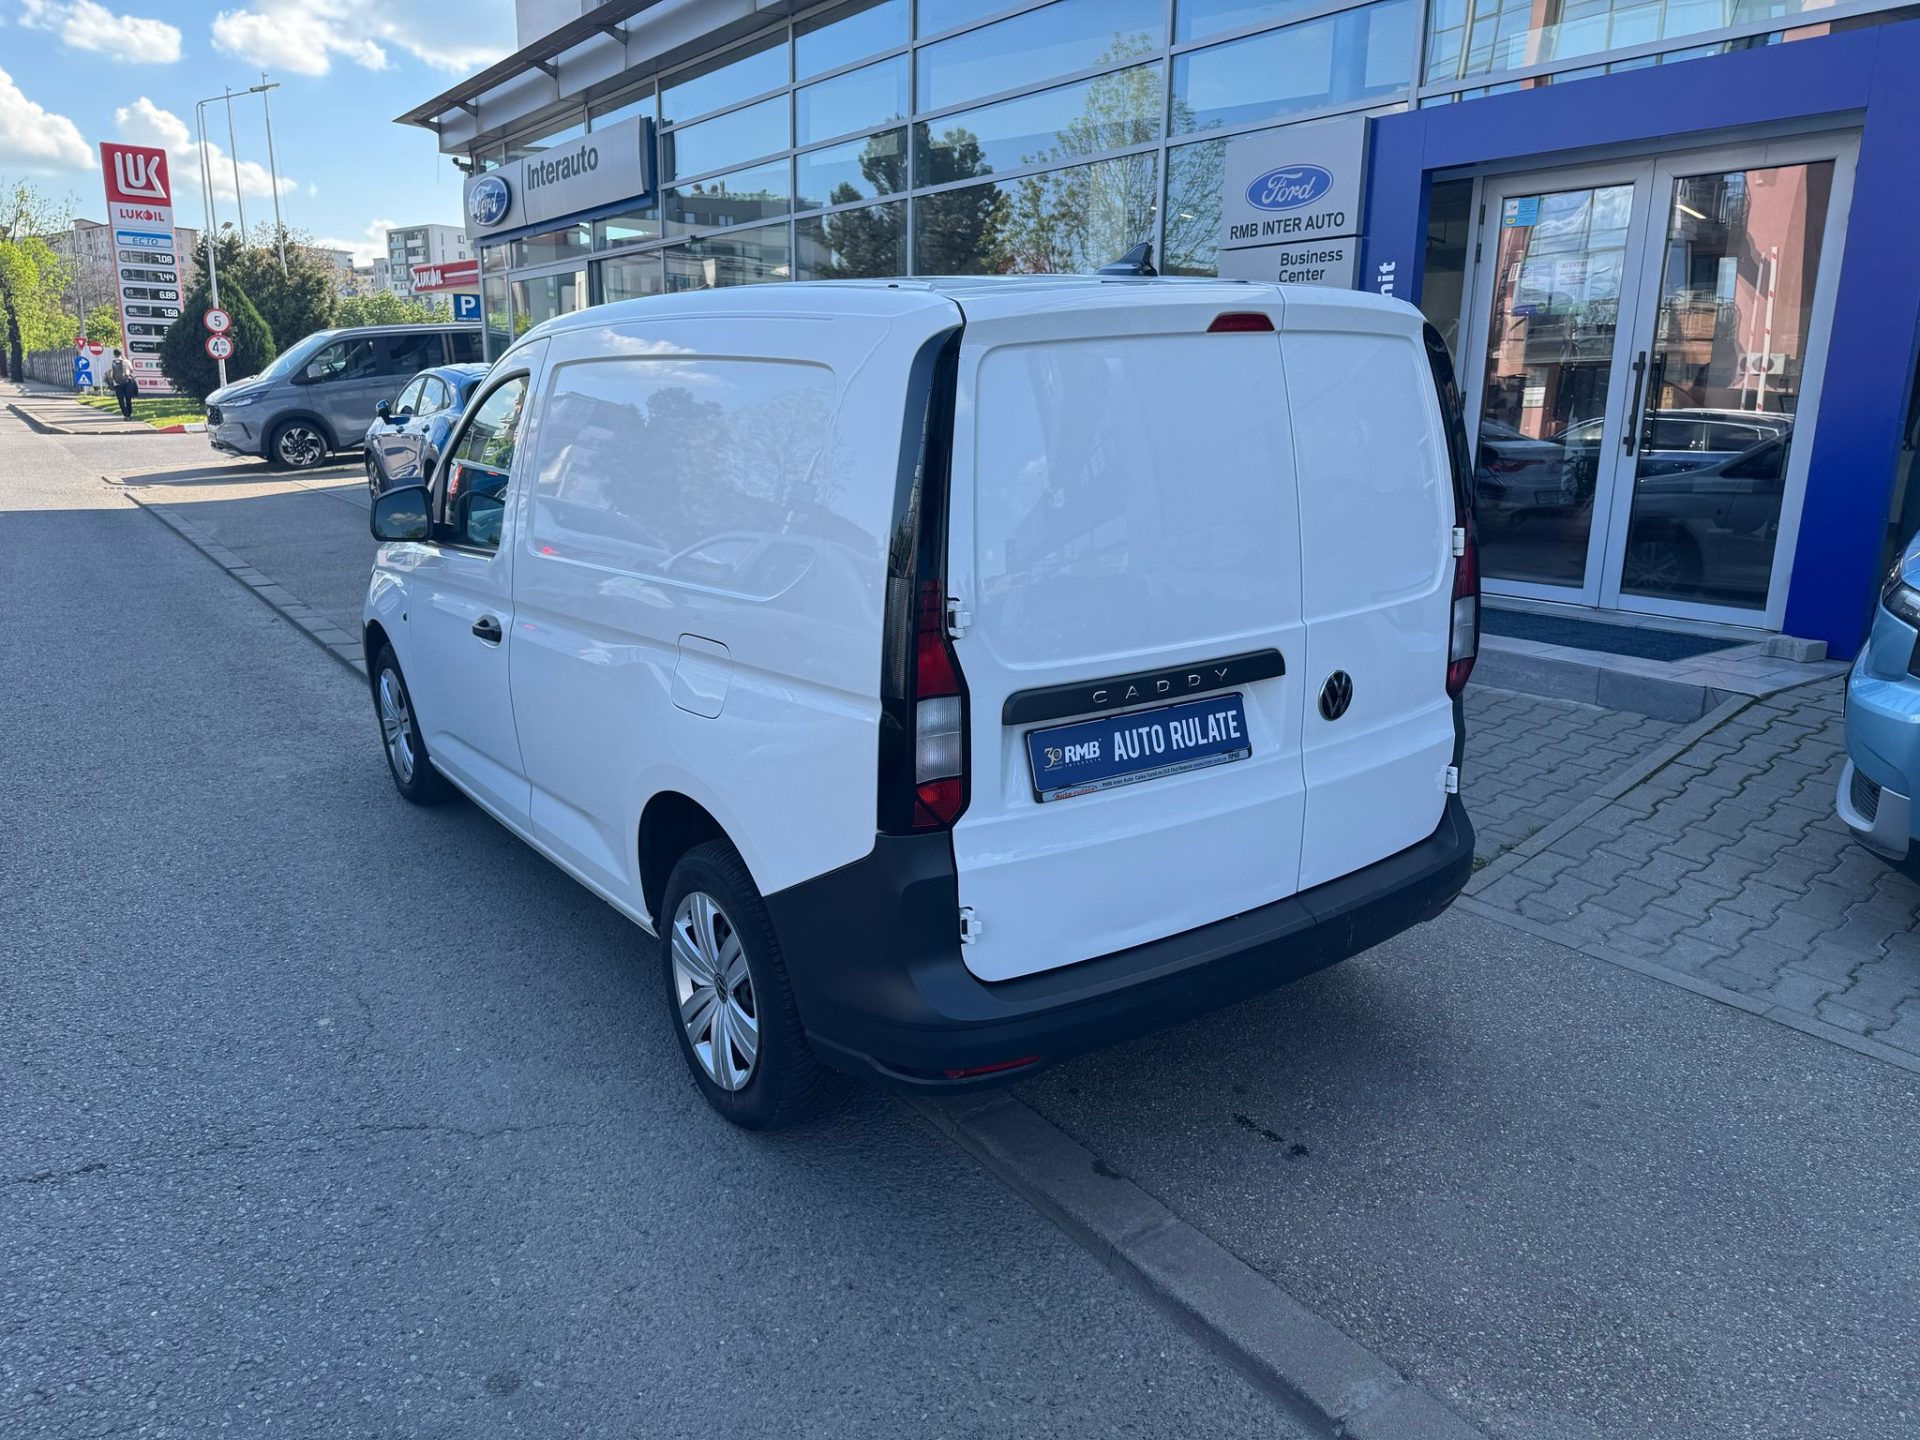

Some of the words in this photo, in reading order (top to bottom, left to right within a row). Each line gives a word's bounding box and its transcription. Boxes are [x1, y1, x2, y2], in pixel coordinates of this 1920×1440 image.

[527, 145, 599, 190] Interauto
[1262, 171, 1315, 204] Ford
[119, 208, 165, 222] LUKOIL
[1230, 222, 1258, 240] RMB
[1262, 217, 1302, 236] INTER
[1304, 211, 1345, 231] AUTO
[132, 237, 159, 246] ECTO
[1280, 248, 1343, 267] Business
[415, 267, 444, 288] LUKOIL
[1278, 267, 1326, 283] Center
[460, 296, 476, 316] P
[214, 315, 222, 327] 5
[212, 341, 220, 353] 4
[1092, 667, 1228, 703] CADDY
[1113, 724, 1164, 762] AUTO
[1168, 709, 1241, 750] RULATE
[1064, 740, 1101, 763] RMB
